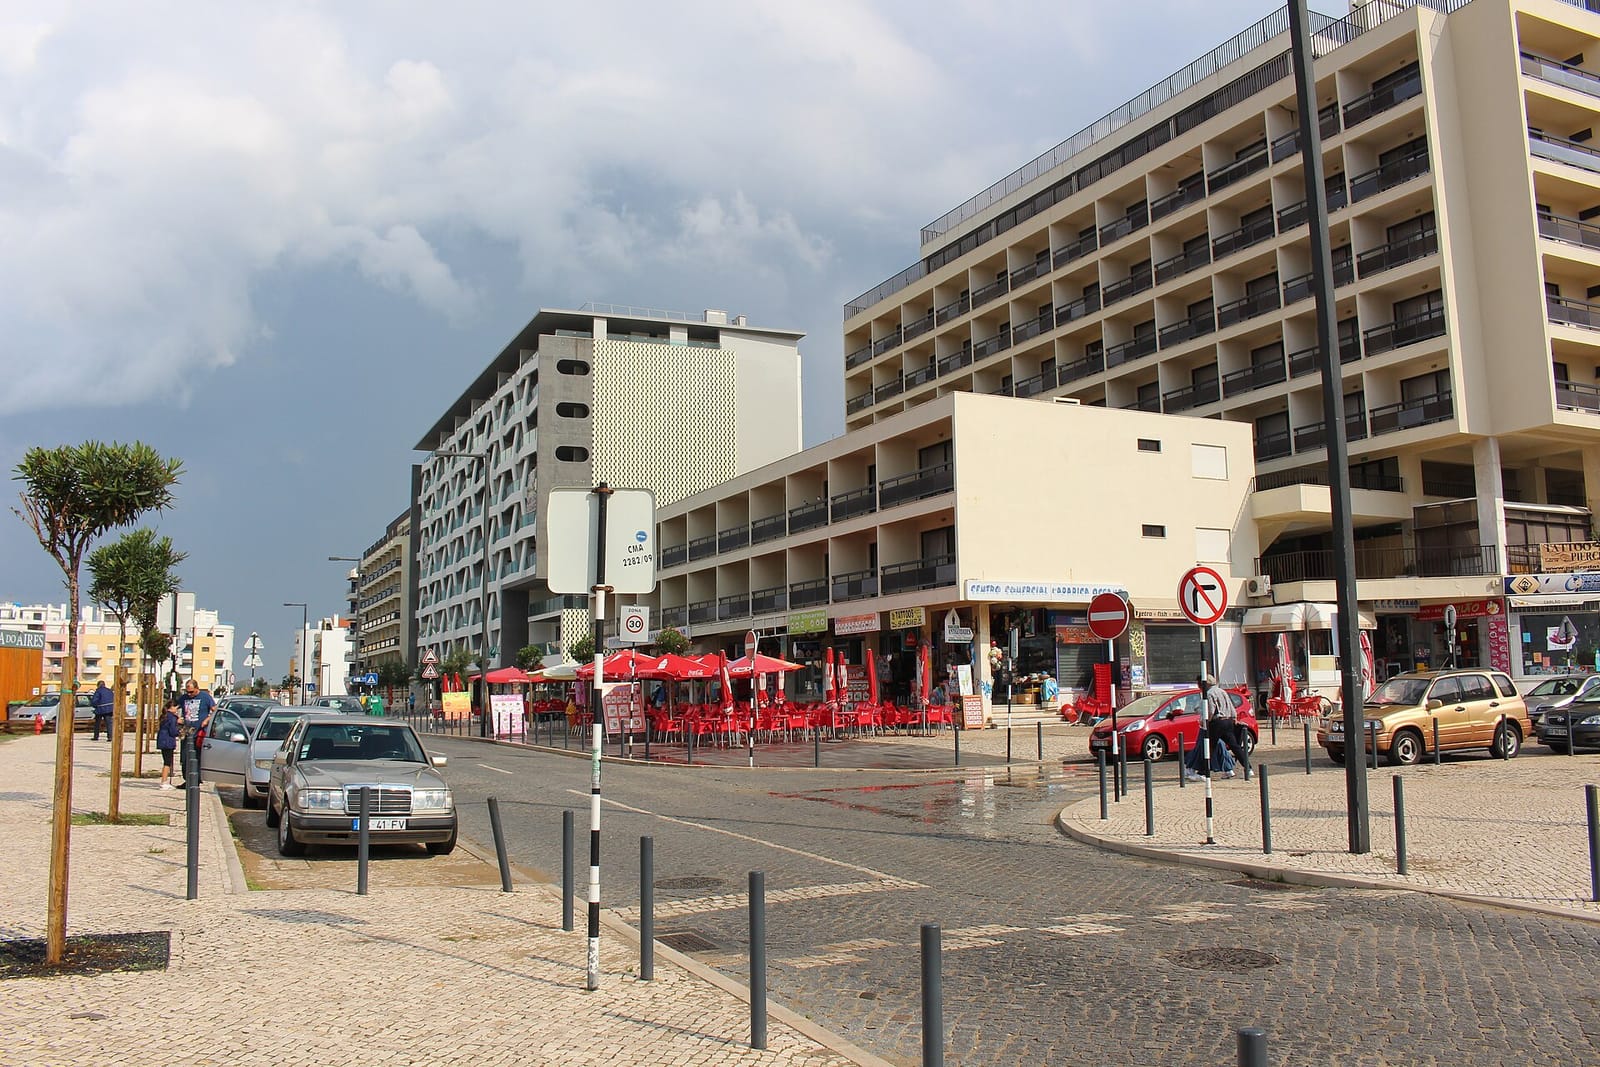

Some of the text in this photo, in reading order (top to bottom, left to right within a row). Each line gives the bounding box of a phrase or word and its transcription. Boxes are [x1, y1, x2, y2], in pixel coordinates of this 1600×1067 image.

[627, 544, 644, 554] CMA
[970, 584, 1002, 593] CENTRO
[629, 620, 641, 628] 30
[16, 633, 44, 648] AIRES
